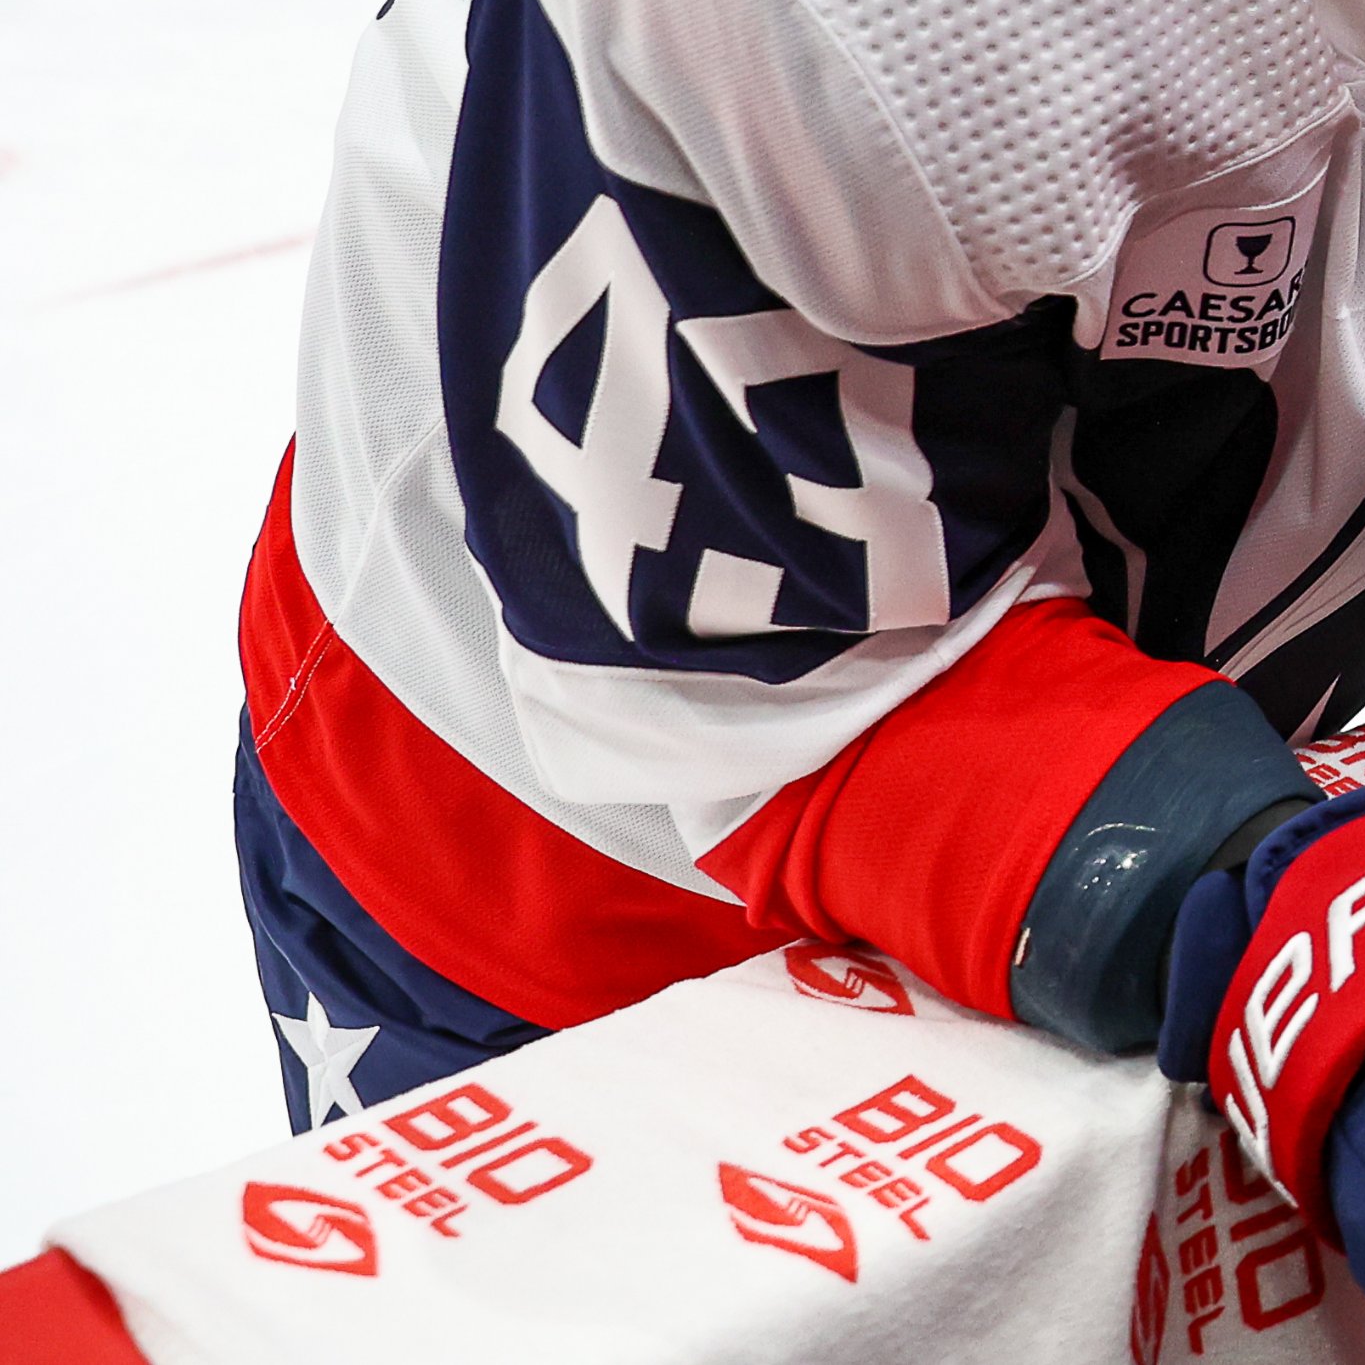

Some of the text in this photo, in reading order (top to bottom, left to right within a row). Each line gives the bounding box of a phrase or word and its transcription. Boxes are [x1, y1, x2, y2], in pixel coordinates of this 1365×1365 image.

[1121, 267, 1304, 323] CAESAR
[322, 1130, 471, 1239] STEEL
[384, 1081, 595, 1207] BIO
[782, 1127, 932, 1241] STEEL
[831, 1073, 1044, 1203] BIO
[1175, 1147, 1226, 1357] STEEL
